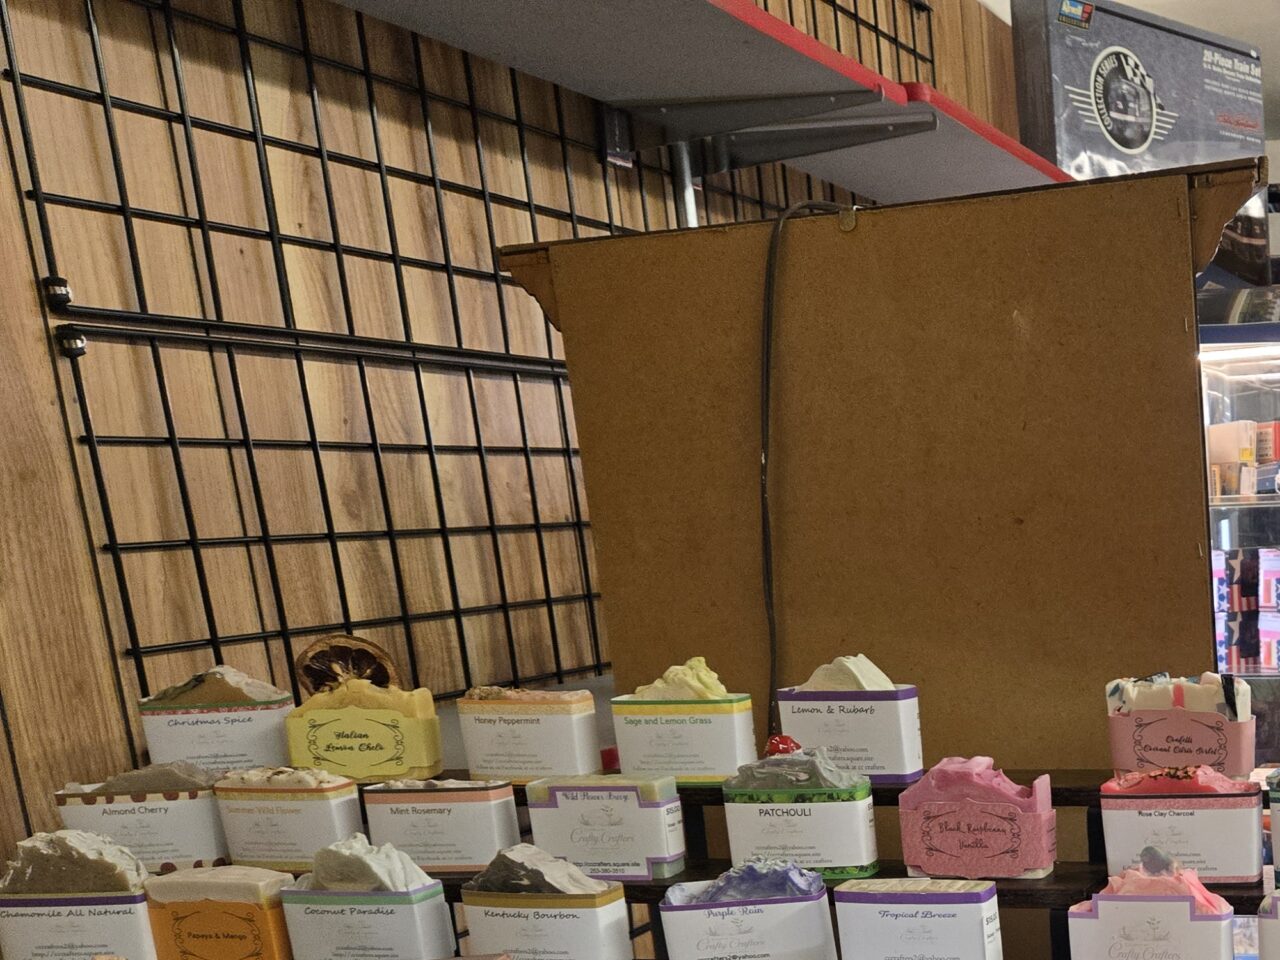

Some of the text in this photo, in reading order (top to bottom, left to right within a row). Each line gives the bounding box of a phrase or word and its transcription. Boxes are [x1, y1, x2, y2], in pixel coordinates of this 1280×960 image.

[791, 705, 823, 715] Lemon
[826, 706, 835, 714] &
[167, 715, 254, 728] Christmas Spice
[474, 716, 540, 727] Honey Peppermint
[624, 716, 712, 727] Sage and Lemon Grass
[102, 805, 169, 817] Almond Cherry
[390, 806, 452, 817] Mint Rosemary
[758, 808, 812, 817] PATCHOULI
[0, 907, 136, 918] Chamomile All Natural
[304, 906, 396, 915] Coconut Paradise
[483, 909, 581, 920] Kentucky Bourbon
[704, 906, 764, 920] Purple Rain
[878, 910, 958, 921] Tropical Breeze
